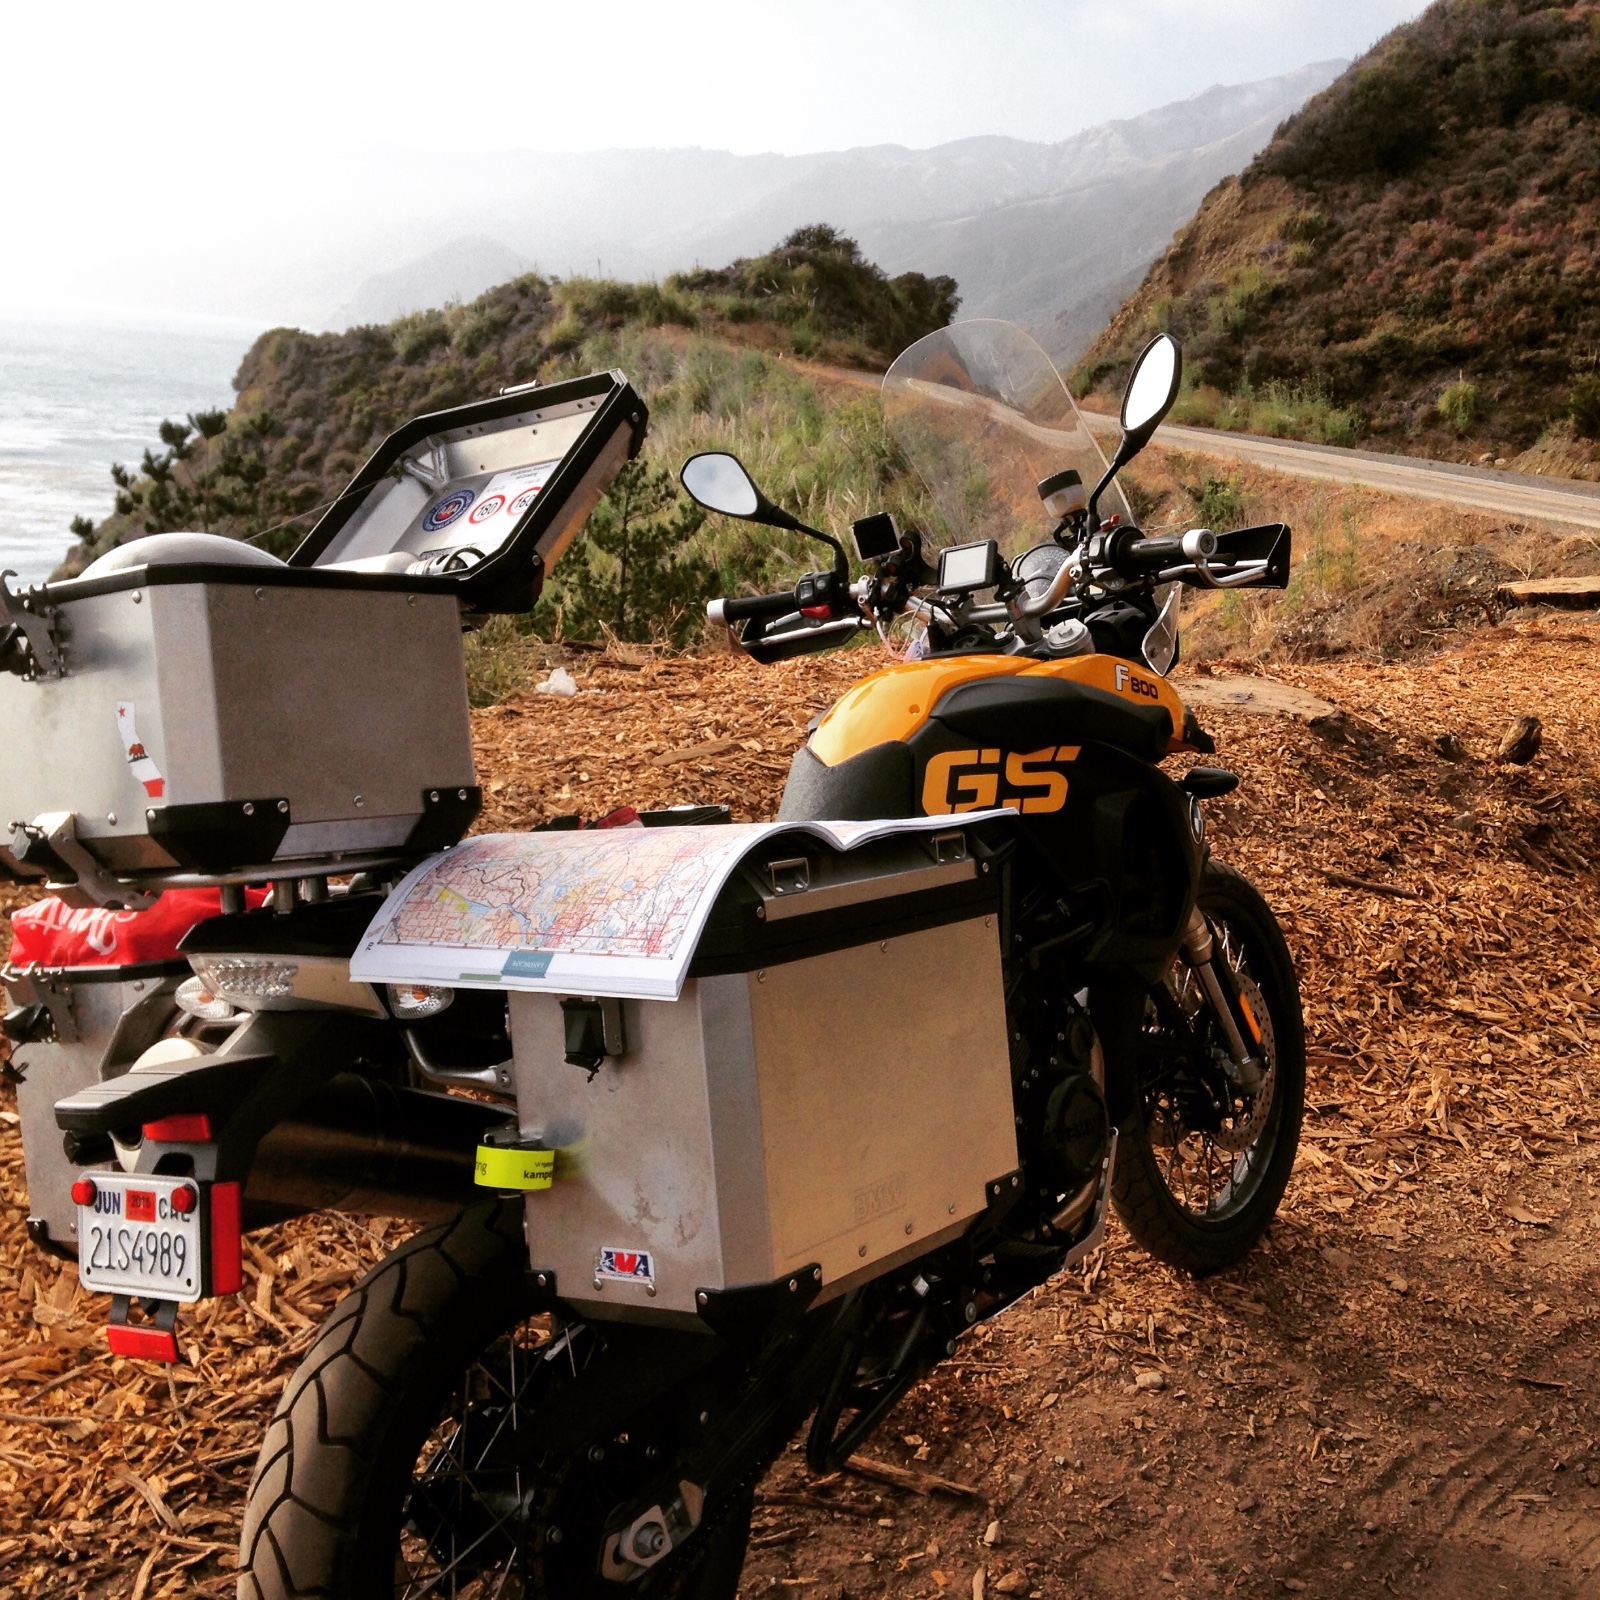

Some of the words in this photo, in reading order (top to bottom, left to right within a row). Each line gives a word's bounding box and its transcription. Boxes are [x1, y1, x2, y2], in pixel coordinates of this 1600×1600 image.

[477, 502, 498, 516] 180
[515, 494, 538, 508] 160
[1115, 664, 1129, 691] F
[1130, 680, 1159, 700] 800
[922, 746, 1082, 816] GS
[95, 1190, 121, 1215] JUN
[91, 1226, 186, 1277] 21S4989
[597, 1251, 651, 1277] AMA
